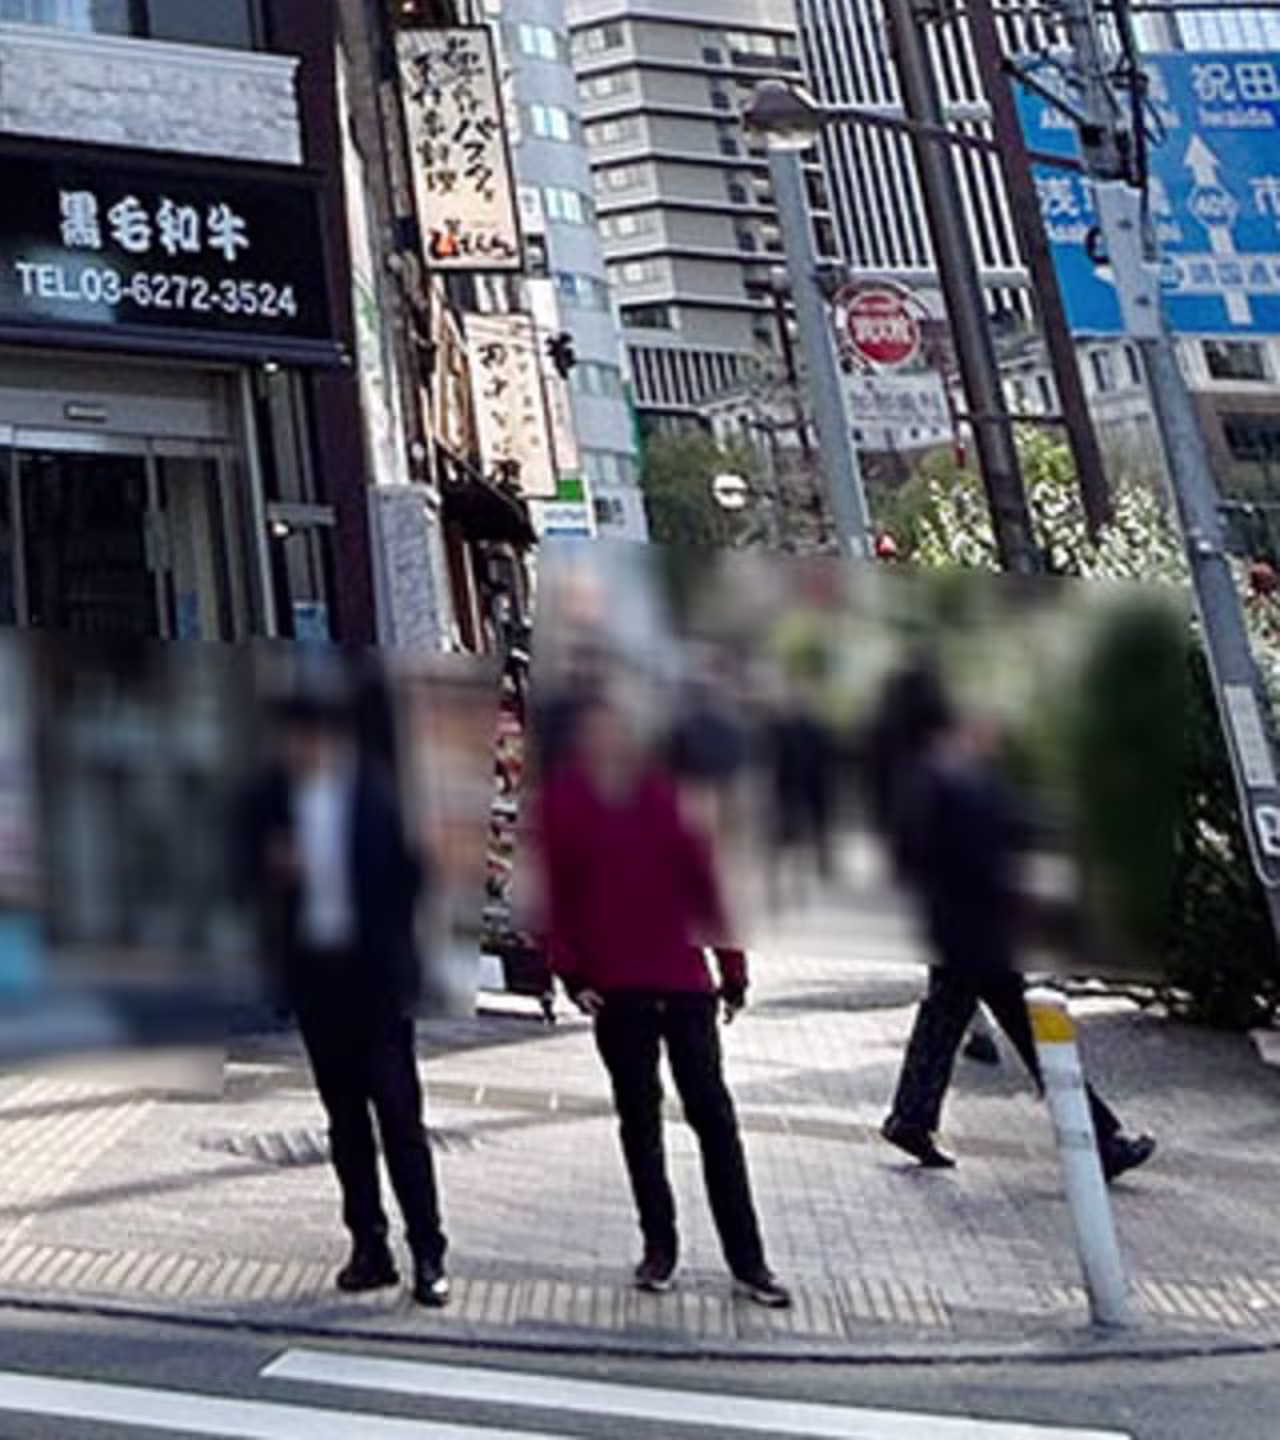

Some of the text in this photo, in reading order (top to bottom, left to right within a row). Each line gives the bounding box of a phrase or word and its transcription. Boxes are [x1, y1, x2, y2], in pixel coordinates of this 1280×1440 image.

[58, 189, 250, 262] 黒毛和牛
[14, 261, 298, 317] TEL03-6272-3524
